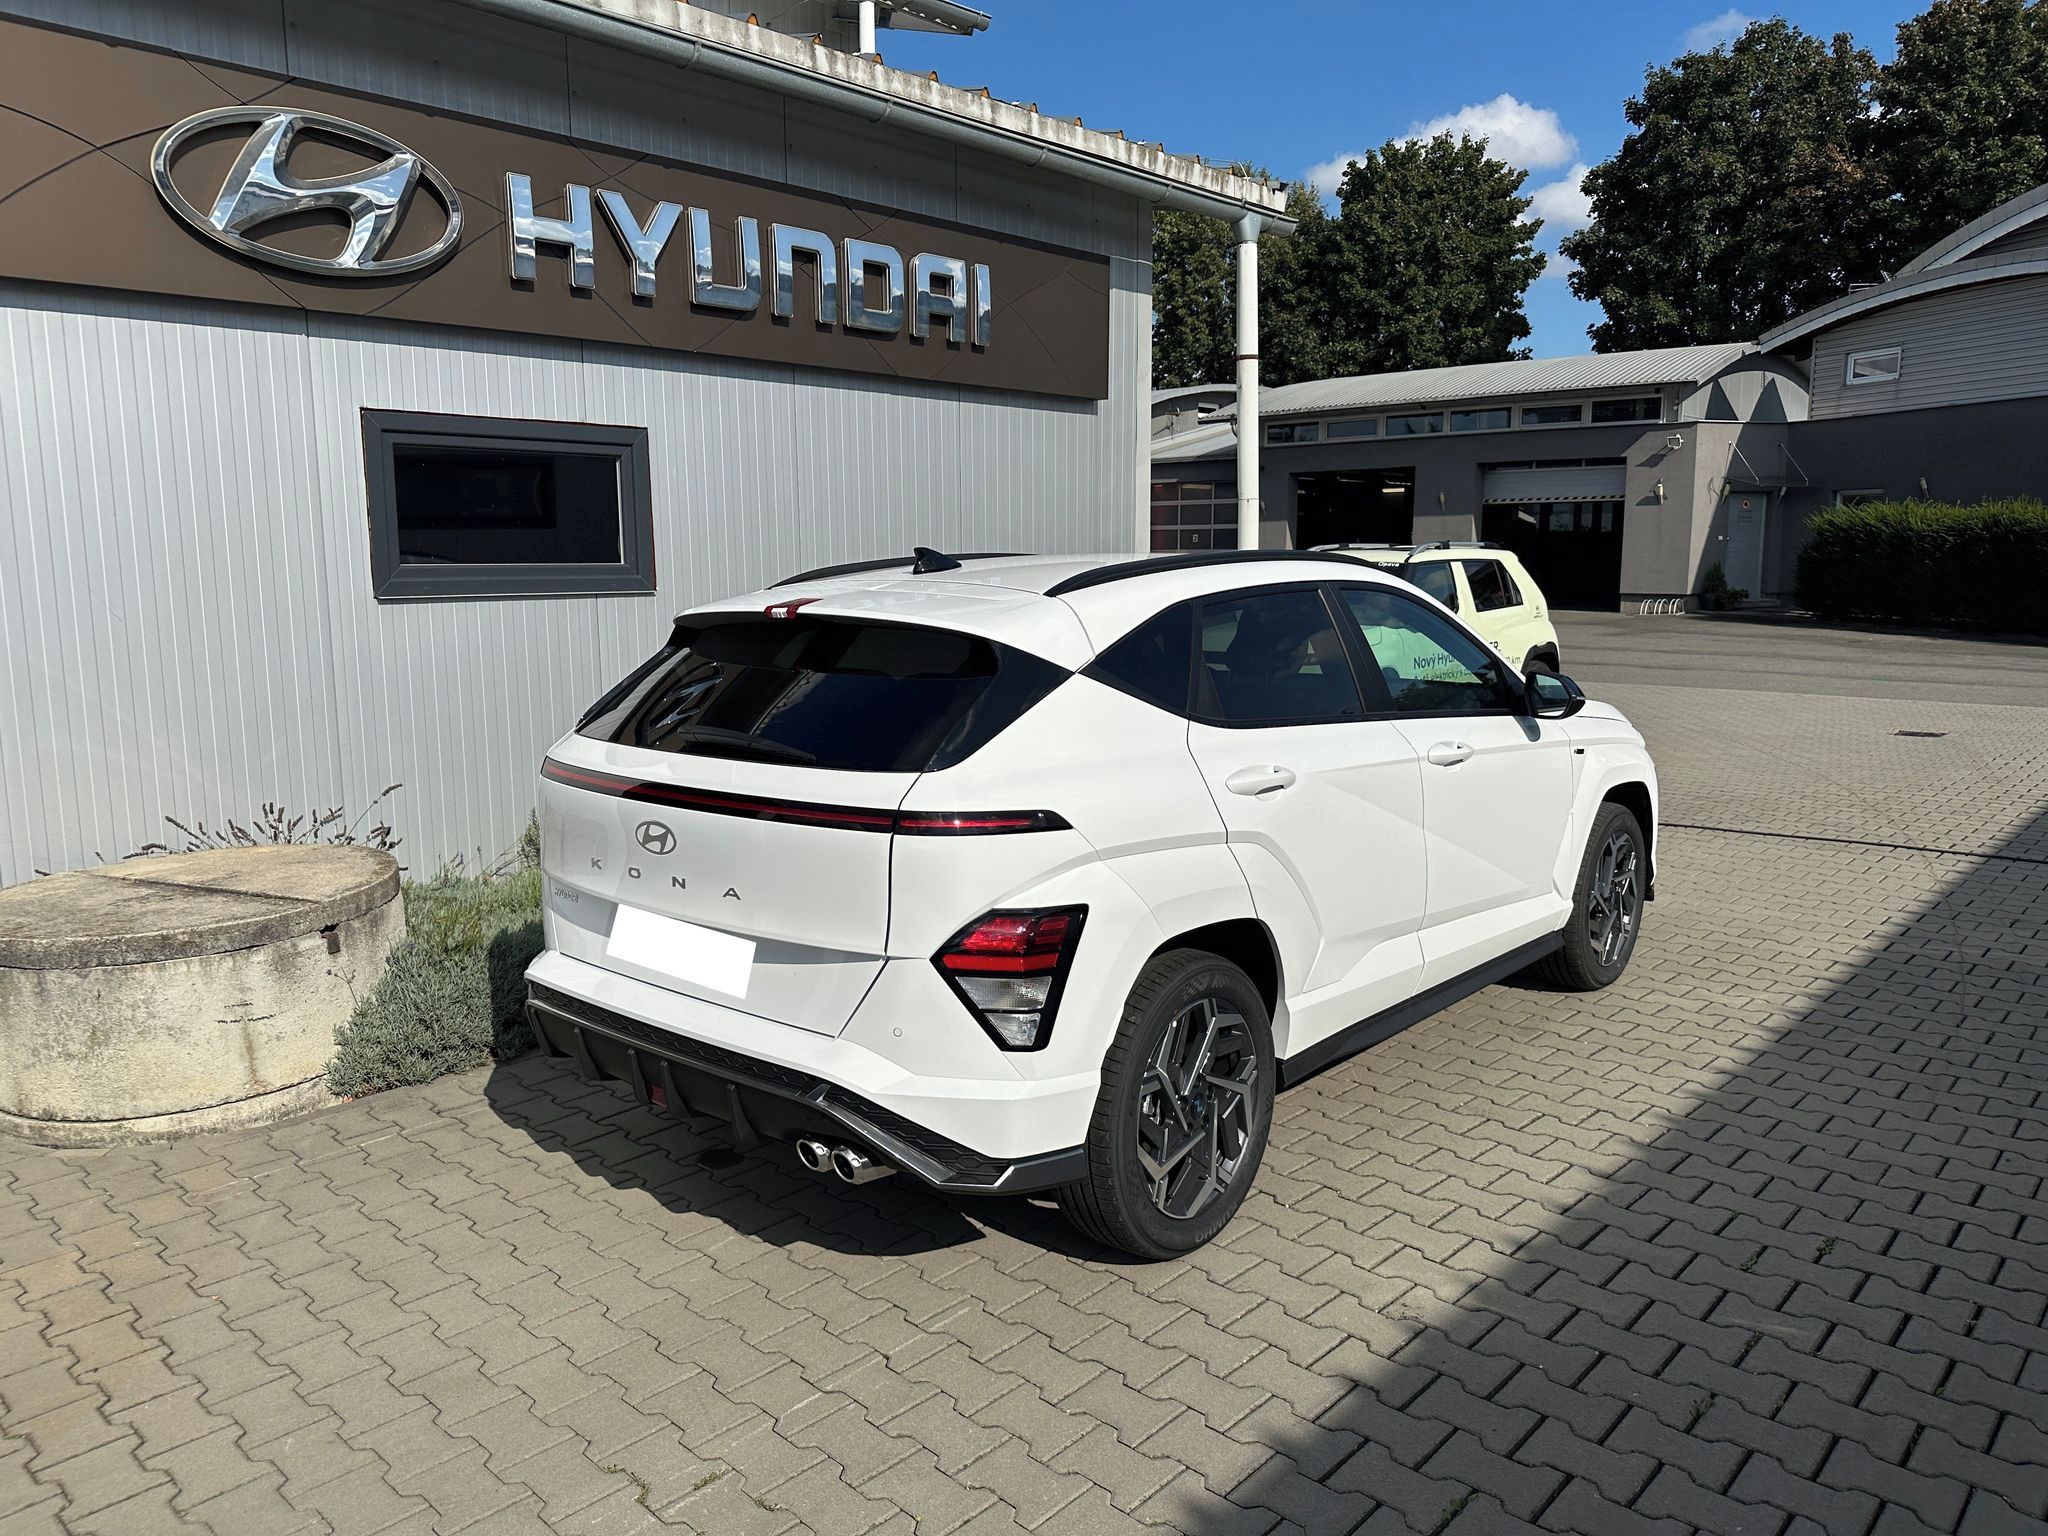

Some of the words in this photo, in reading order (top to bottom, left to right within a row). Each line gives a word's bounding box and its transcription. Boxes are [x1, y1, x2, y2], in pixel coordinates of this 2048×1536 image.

[505, 172, 991, 347] HYUNDAI
[1413, 653, 1436, 670] Nový
[591, 857, 742, 901] KONA
